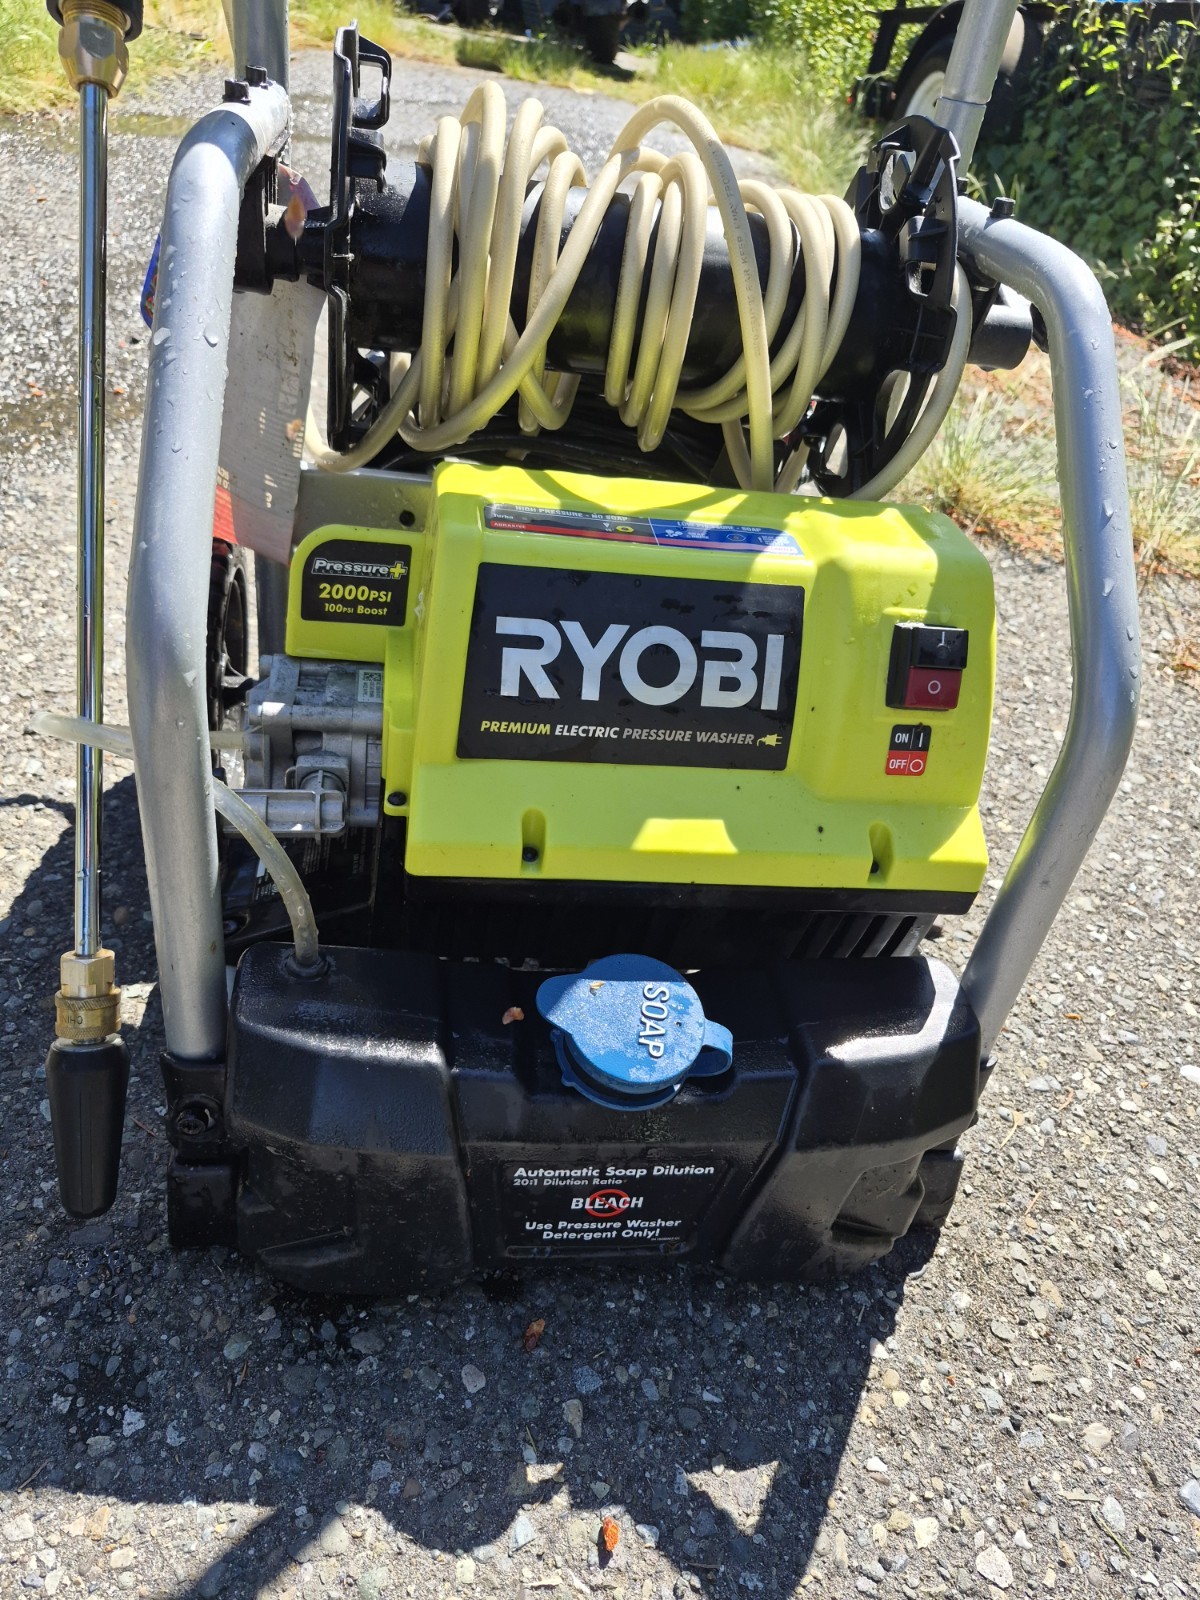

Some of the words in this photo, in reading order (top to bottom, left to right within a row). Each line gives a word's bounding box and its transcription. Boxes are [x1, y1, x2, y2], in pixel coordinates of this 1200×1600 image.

[515, 505, 537, 513] HIGH
[538, 507, 584, 518] PRESSURE
[319, 583, 392, 603] 2000PSI
[324, 603, 354, 614] 100PSI
[357, 605, 388, 615] Boost
[496, 616, 784, 711] RYOBI
[480, 720, 551, 735] PREMIUM
[554, 724, 620, 739] ELECTRIC
[623, 728, 692, 742] PRESSURE
[696, 731, 755, 745] WASHER
[894, 733, 909, 743] ON
[889, 759, 907, 769] OFF
[638, 983, 670, 1059] SOAP
[513, 1166, 600, 1178] Automatic
[605, 1166, 648, 1178] Soap
[652, 1165, 715, 1176] Dilution
[513, 1178, 538, 1186] 20:1
[543, 1178, 589, 1186] Dilution
[571, 1196, 644, 1210] BLEACH
[525, 1221, 553, 1230] Use
[557, 1220, 622, 1230] Pressure
[626, 1218, 682, 1228] Washer
[542, 1230, 617, 1240] Detergent
[621, 1228, 660, 1239] Only!
